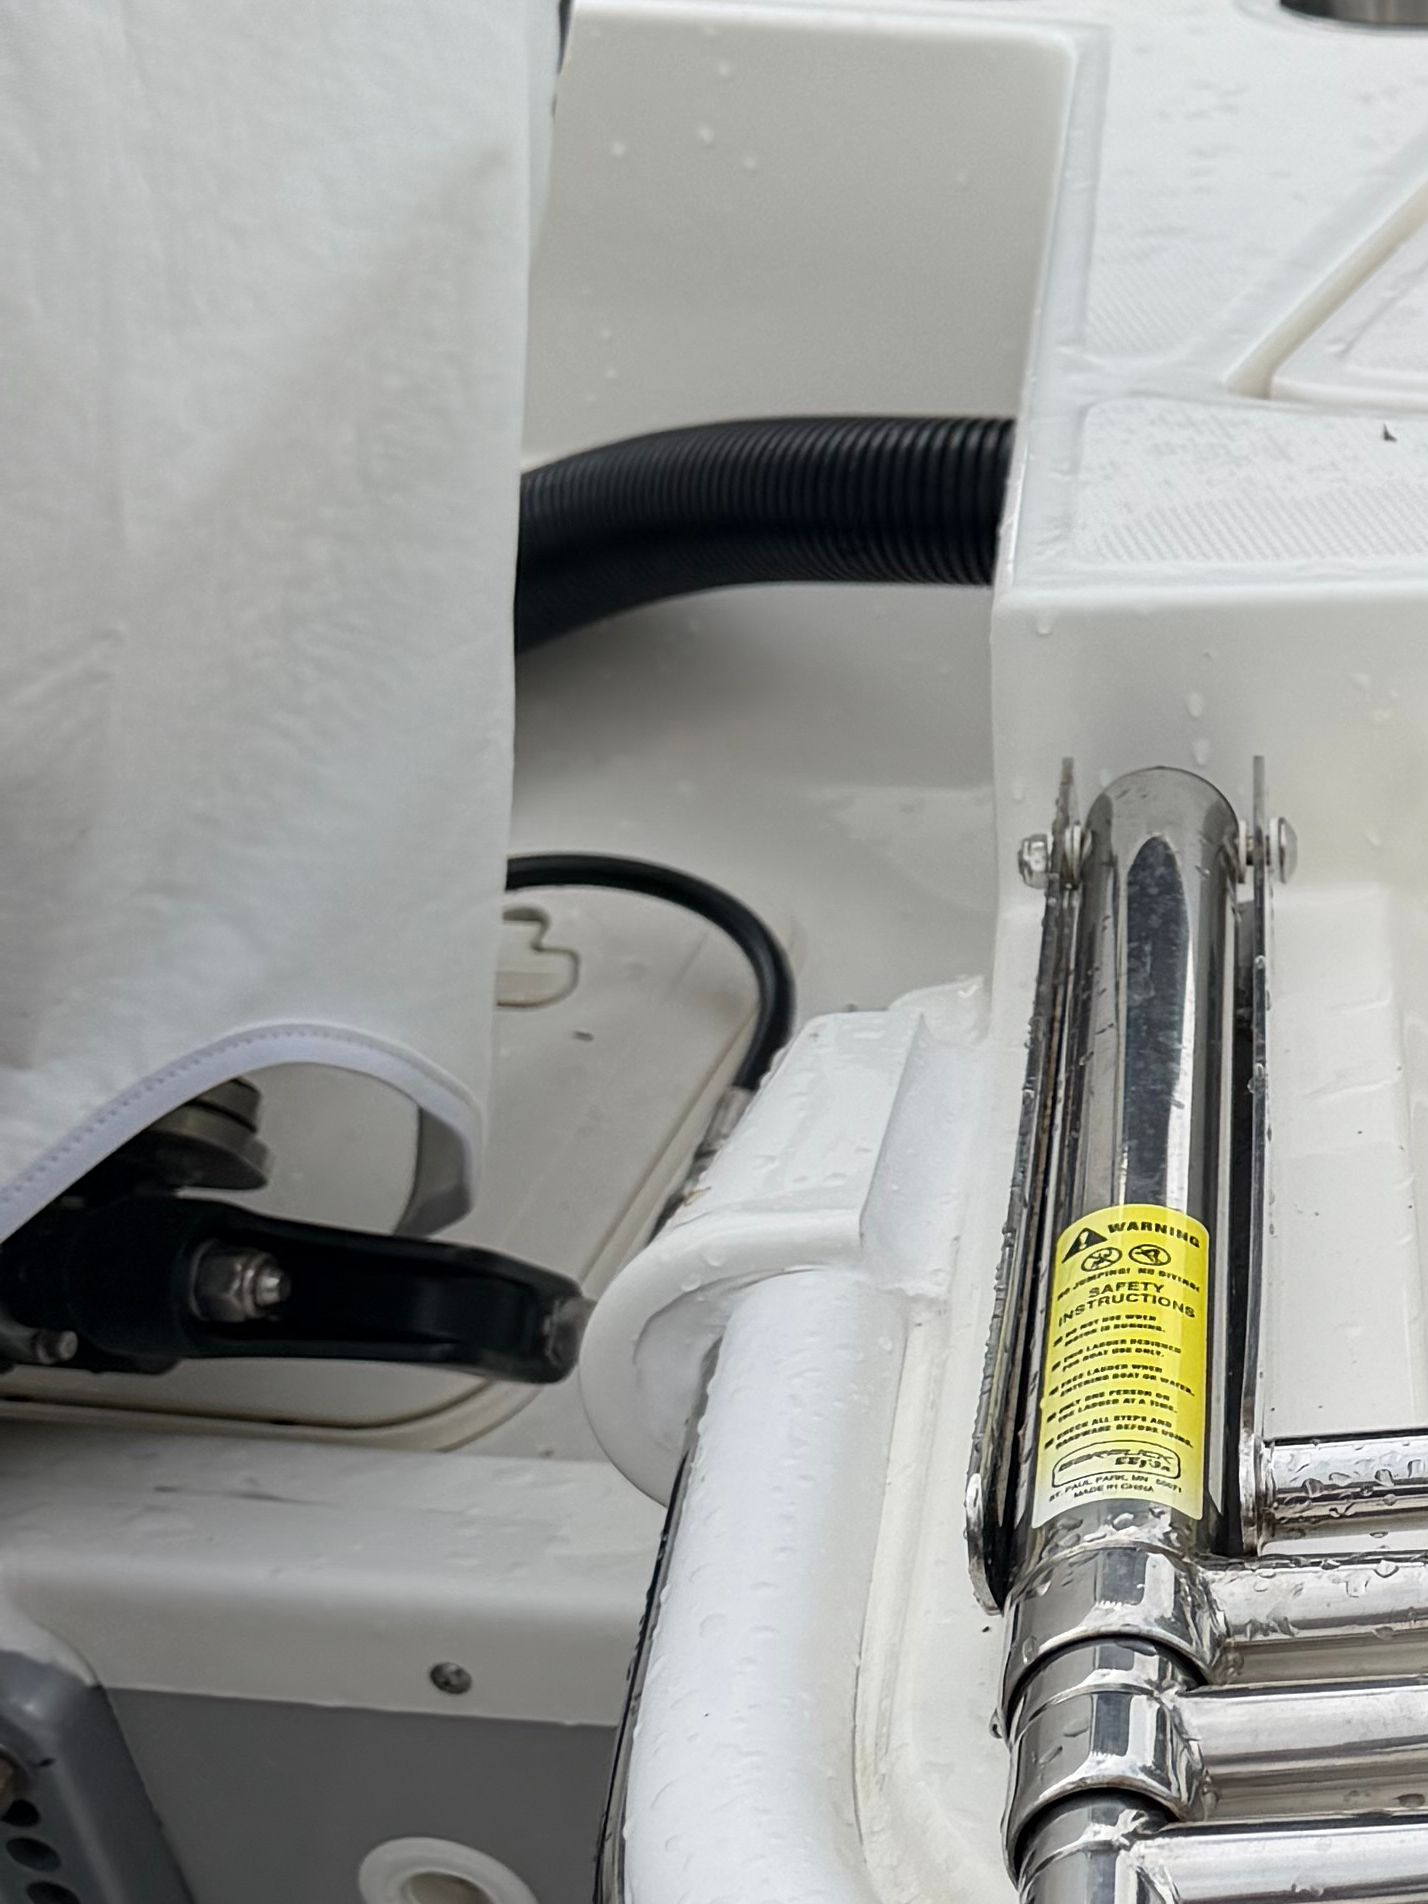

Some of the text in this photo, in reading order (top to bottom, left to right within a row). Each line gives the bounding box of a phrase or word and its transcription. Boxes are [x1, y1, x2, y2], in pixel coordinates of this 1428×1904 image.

[1108, 1221, 1200, 1248] WARNING
[1089, 1281, 1164, 1298] SAFETY
[1058, 1293, 1196, 1327] INSTRUCTIONS
[1092, 1417, 1109, 1425] ALL
[1150, 1418, 1172, 1428] AND
[1074, 1484, 1104, 1497] MADE
[1121, 1483, 1154, 1492] CHINA
